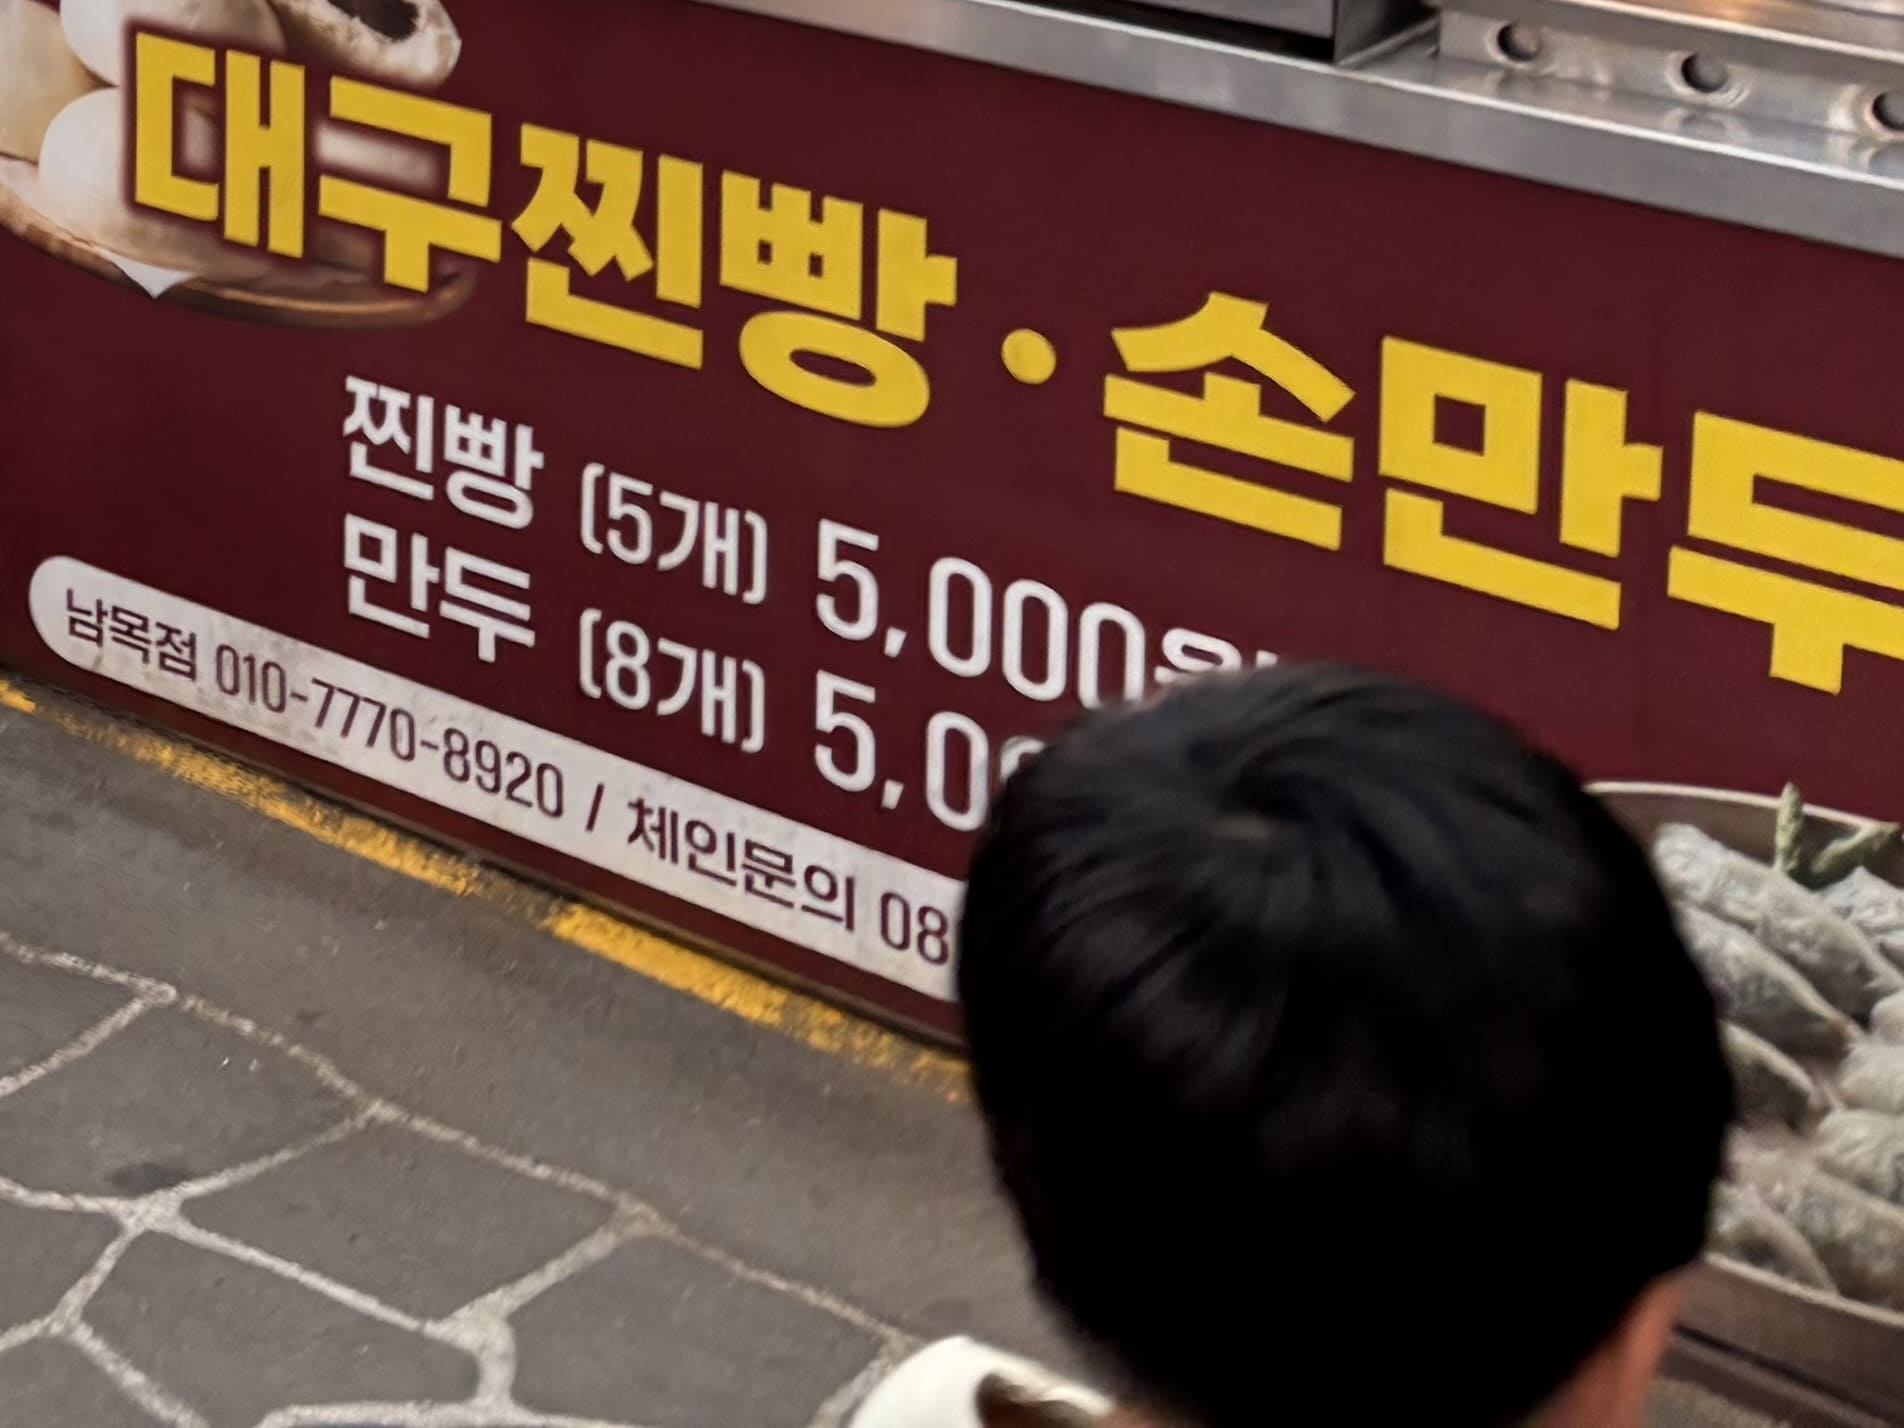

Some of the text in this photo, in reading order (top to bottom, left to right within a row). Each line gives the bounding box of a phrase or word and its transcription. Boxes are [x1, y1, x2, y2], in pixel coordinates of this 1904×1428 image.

[342, 375, 545, 530] 찐빵
[579, 461, 768, 605] (5개)
[342, 511, 538, 663] 만두
[577, 607, 766, 754] (8개)
[64, 587, 200, 681] 남목점
[213, 641, 566, 820] 010-7770-8920
[626, 795, 858, 934] 체인문의
